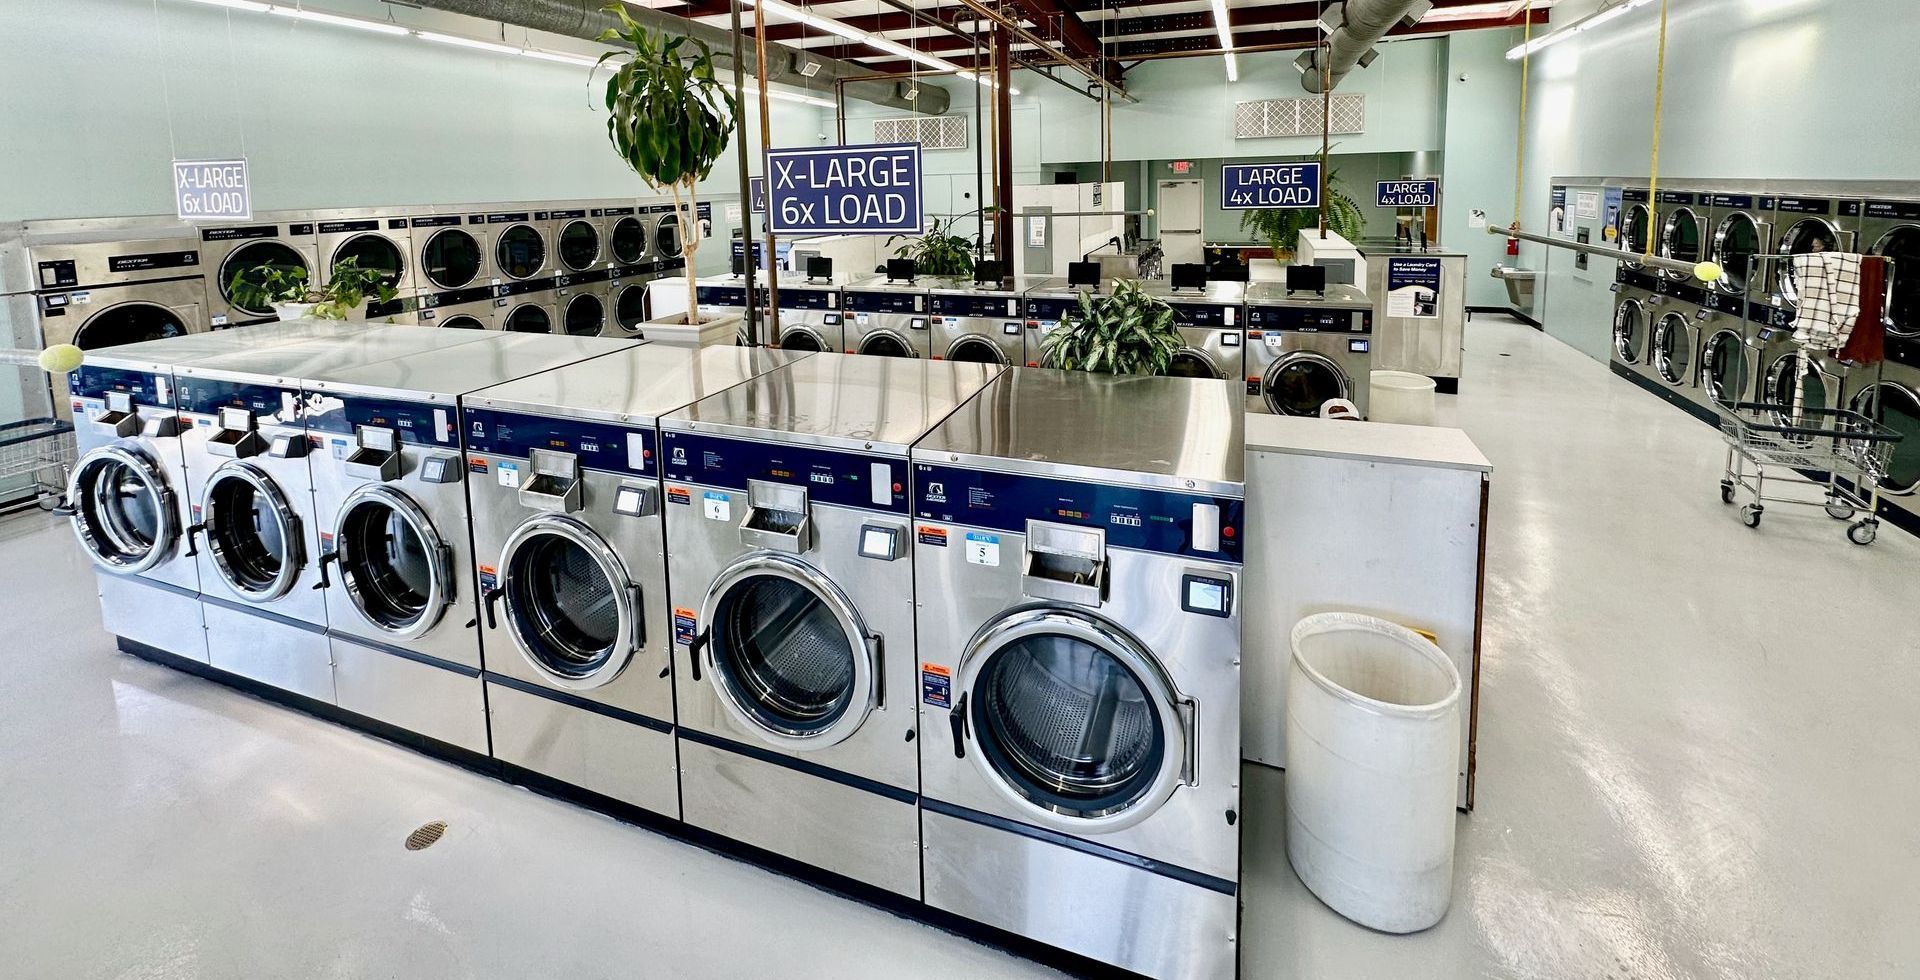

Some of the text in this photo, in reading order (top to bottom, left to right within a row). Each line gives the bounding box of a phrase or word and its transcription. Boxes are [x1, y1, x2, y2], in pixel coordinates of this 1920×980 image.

[178, 167, 244, 189] X-LARGE
[775, 155, 911, 190] X-LARGE
[1238, 168, 1303, 185] LARGE
[1230, 187, 1312, 204] 4x LOAD
[1386, 183, 1426, 194] LARGE
[183, 192, 243, 214] 6x LOAD
[1381, 194, 1431, 205] 4x LOAD
[781, 193, 906, 225] 6x LOAD
[714, 505, 720, 513] 6
[979, 547, 986, 557] 5
